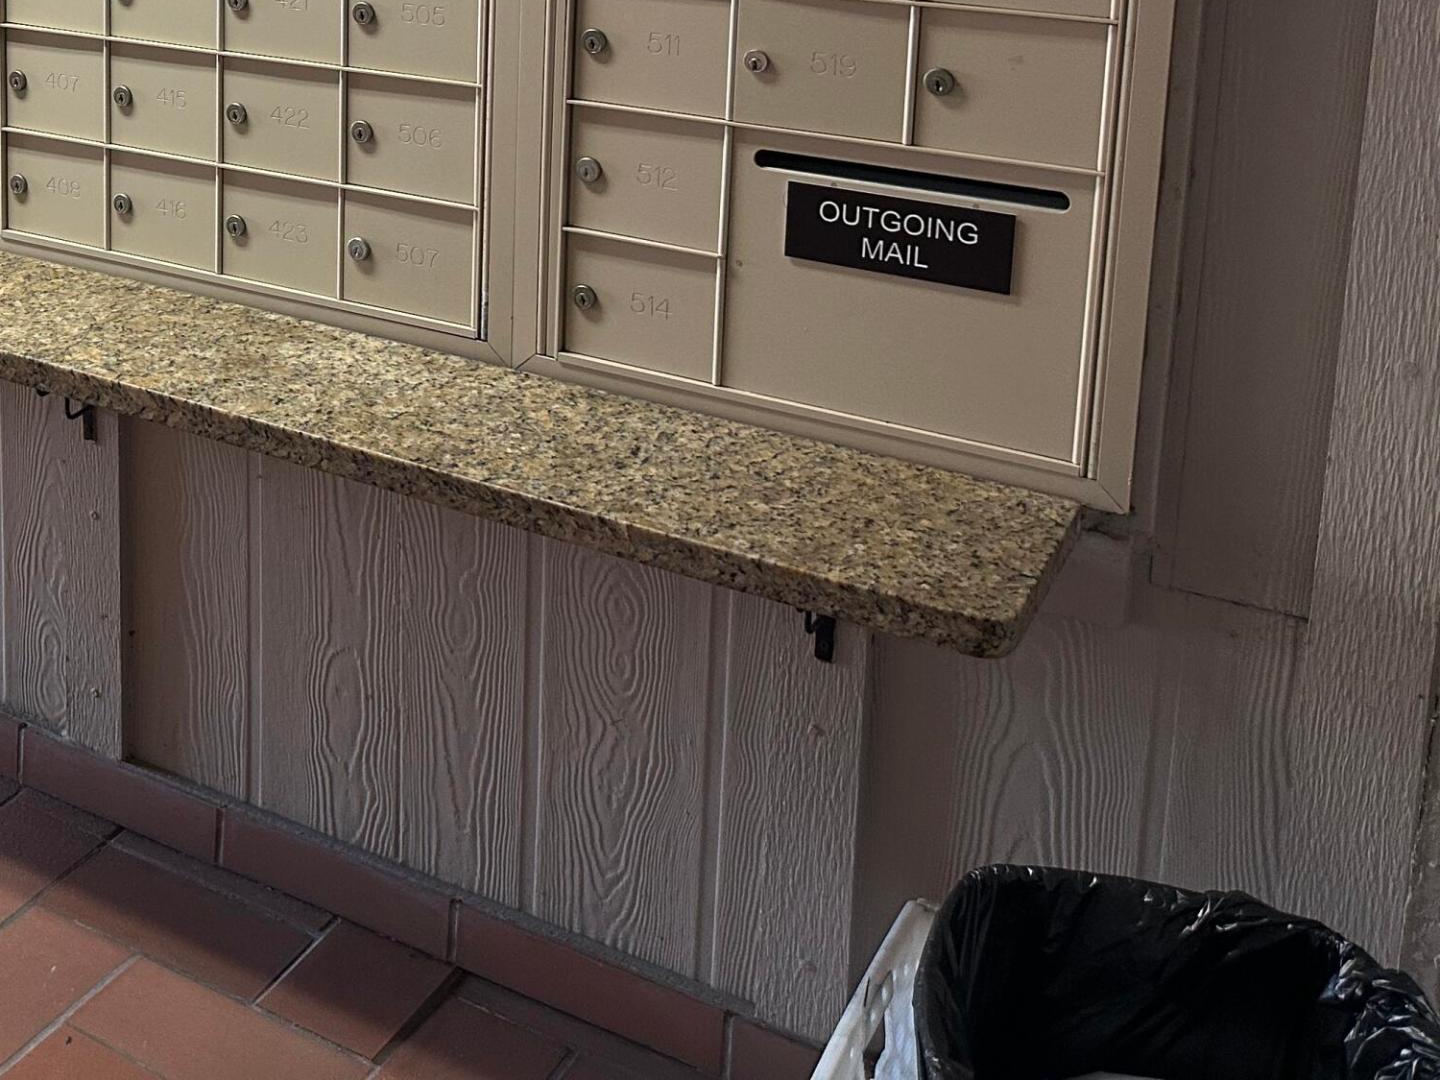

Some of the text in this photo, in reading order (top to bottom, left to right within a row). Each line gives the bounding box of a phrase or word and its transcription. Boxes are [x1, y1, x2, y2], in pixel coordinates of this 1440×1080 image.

[400, 2, 446, 27] 505
[646, 32, 681, 57] 511
[809, 51, 857, 78] 519
[45, 72, 80, 93] 407
[156, 89, 187, 109] 415
[270, 106, 310, 130] 422
[398, 123, 442, 148] 506
[636, 162, 677, 192] 512
[155, 198, 187, 220] 416
[268, 219, 308, 245] 423
[819, 200, 979, 245] OUTGOING
[395, 242, 439, 269] 507
[861, 237, 929, 269] MAIL
[630, 292, 673, 319] 514
